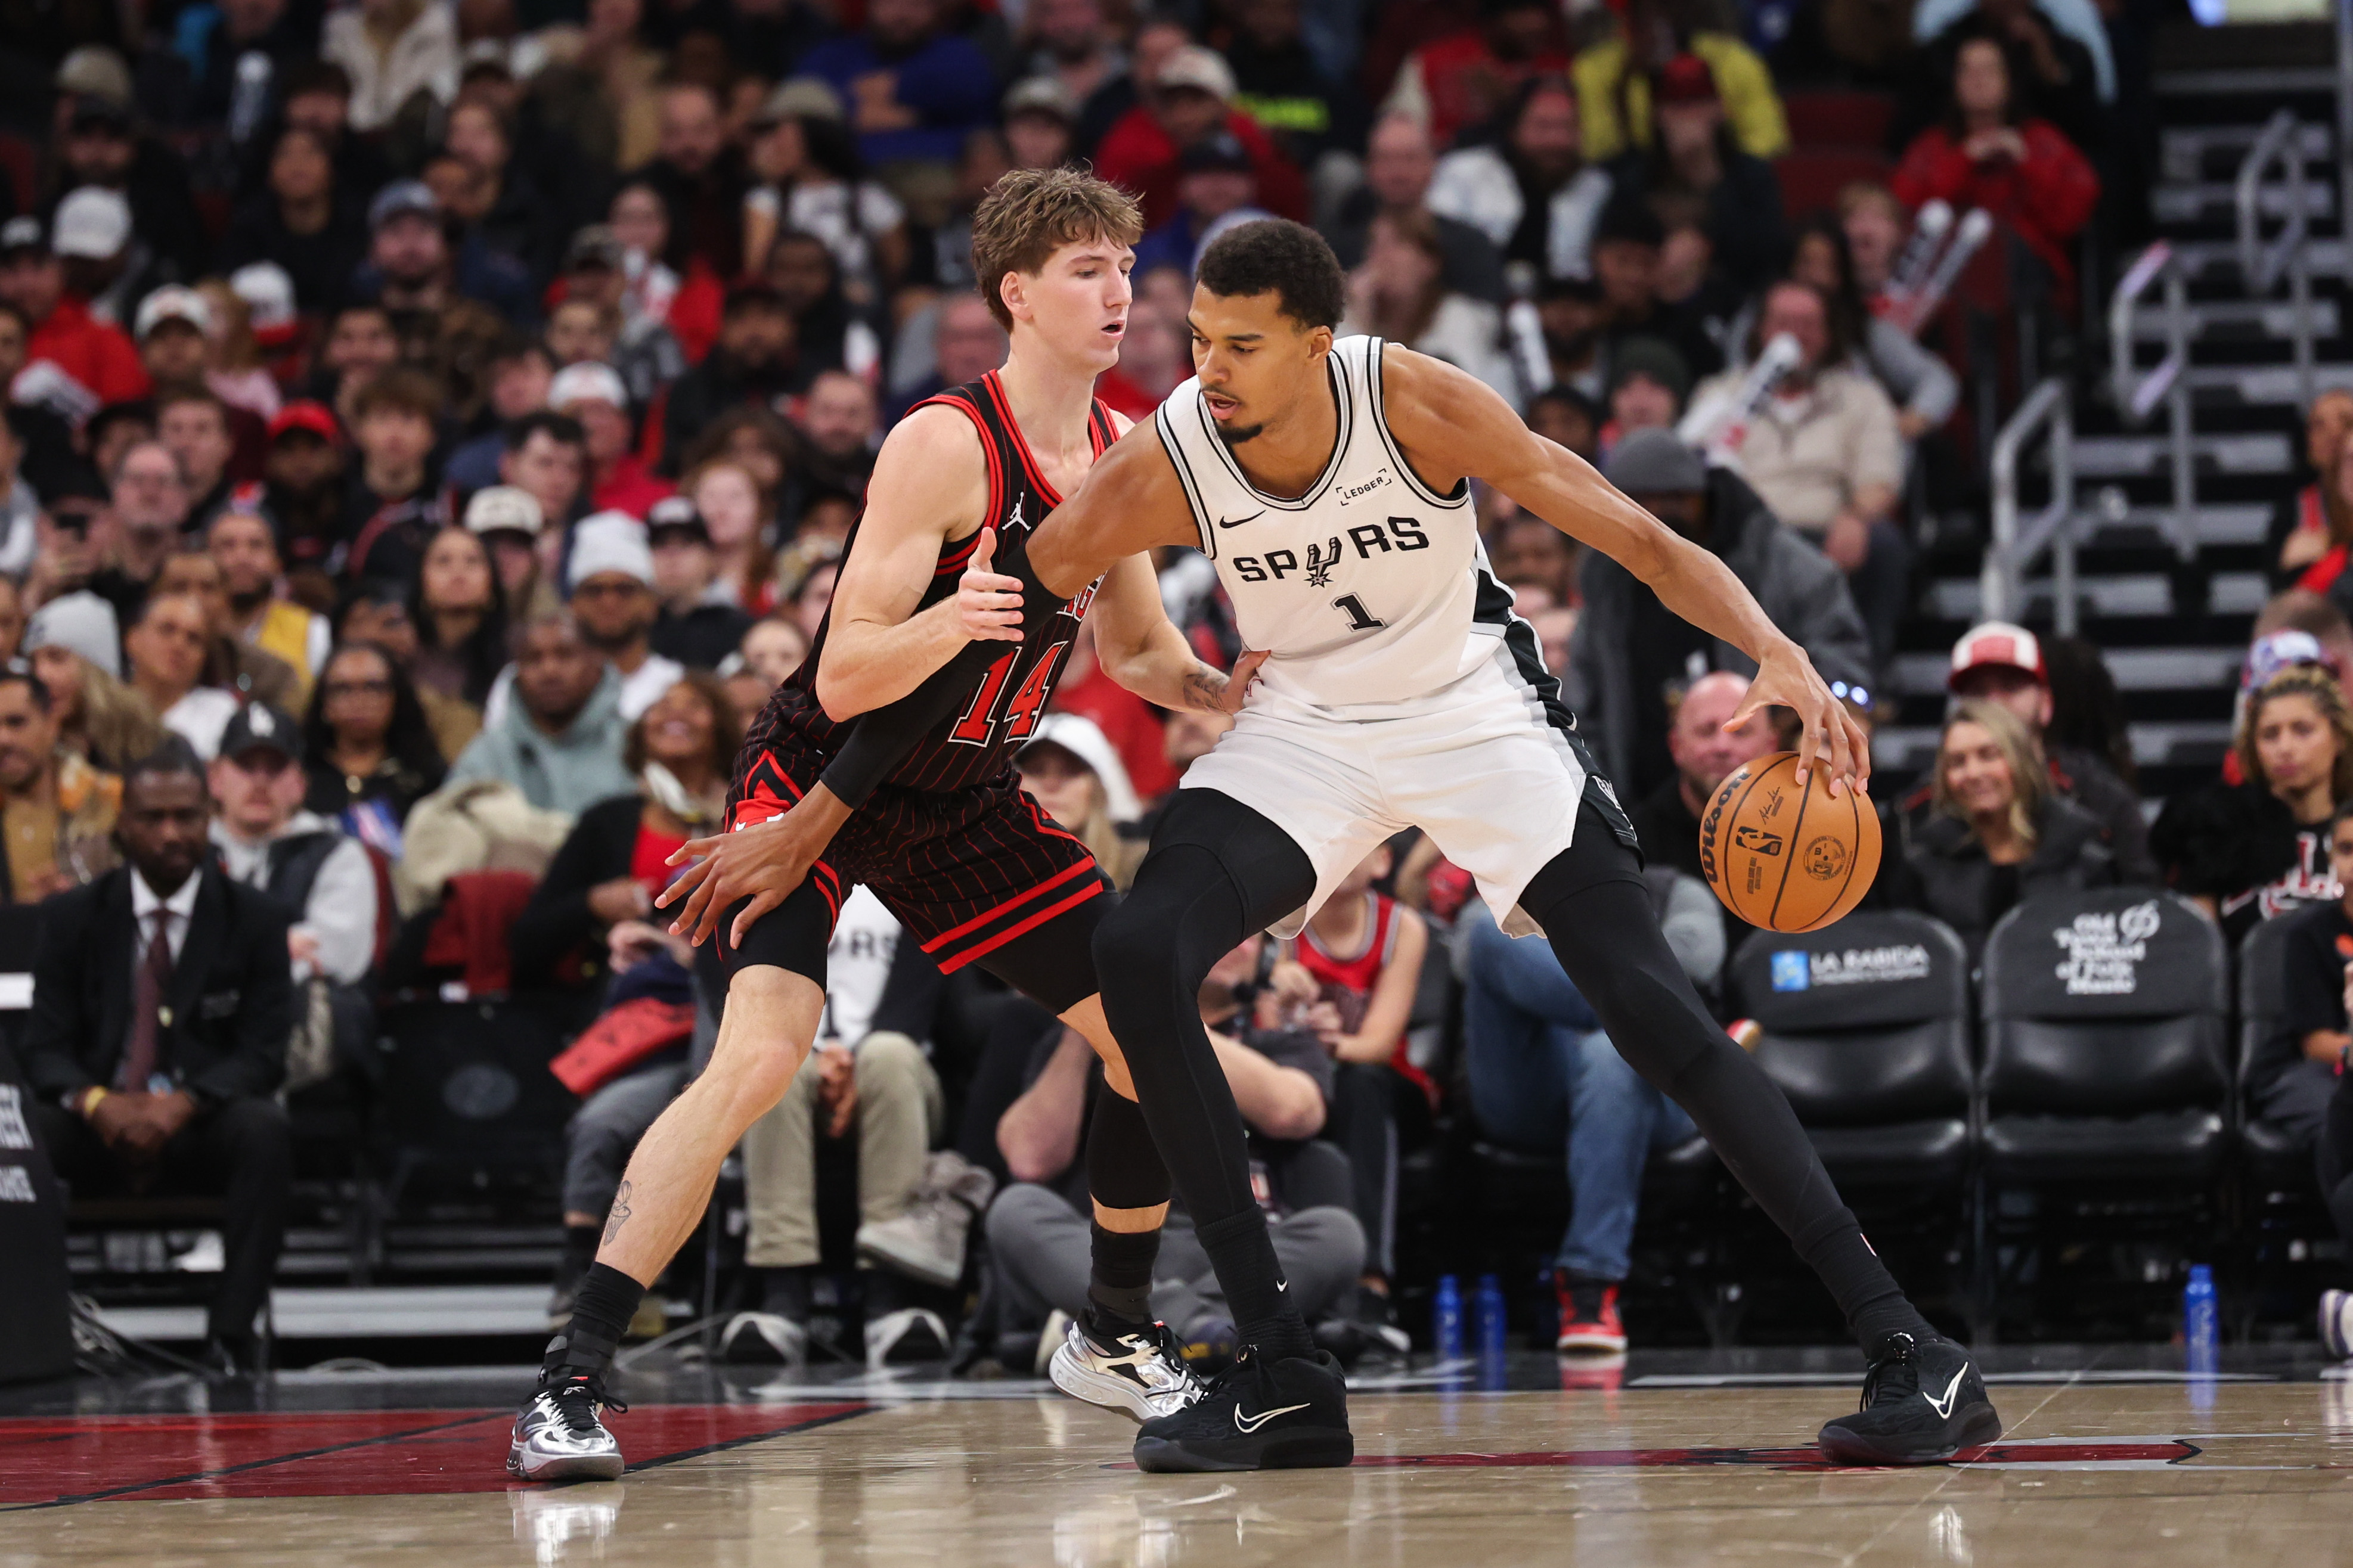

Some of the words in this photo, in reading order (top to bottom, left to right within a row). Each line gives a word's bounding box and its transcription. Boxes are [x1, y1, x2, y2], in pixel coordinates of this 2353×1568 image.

[1343, 477, 1384, 499] LEDGER
[1233, 516, 1430, 588] SPURS
[1330, 592, 1389, 632] 1
[947, 640, 1069, 747] 14
